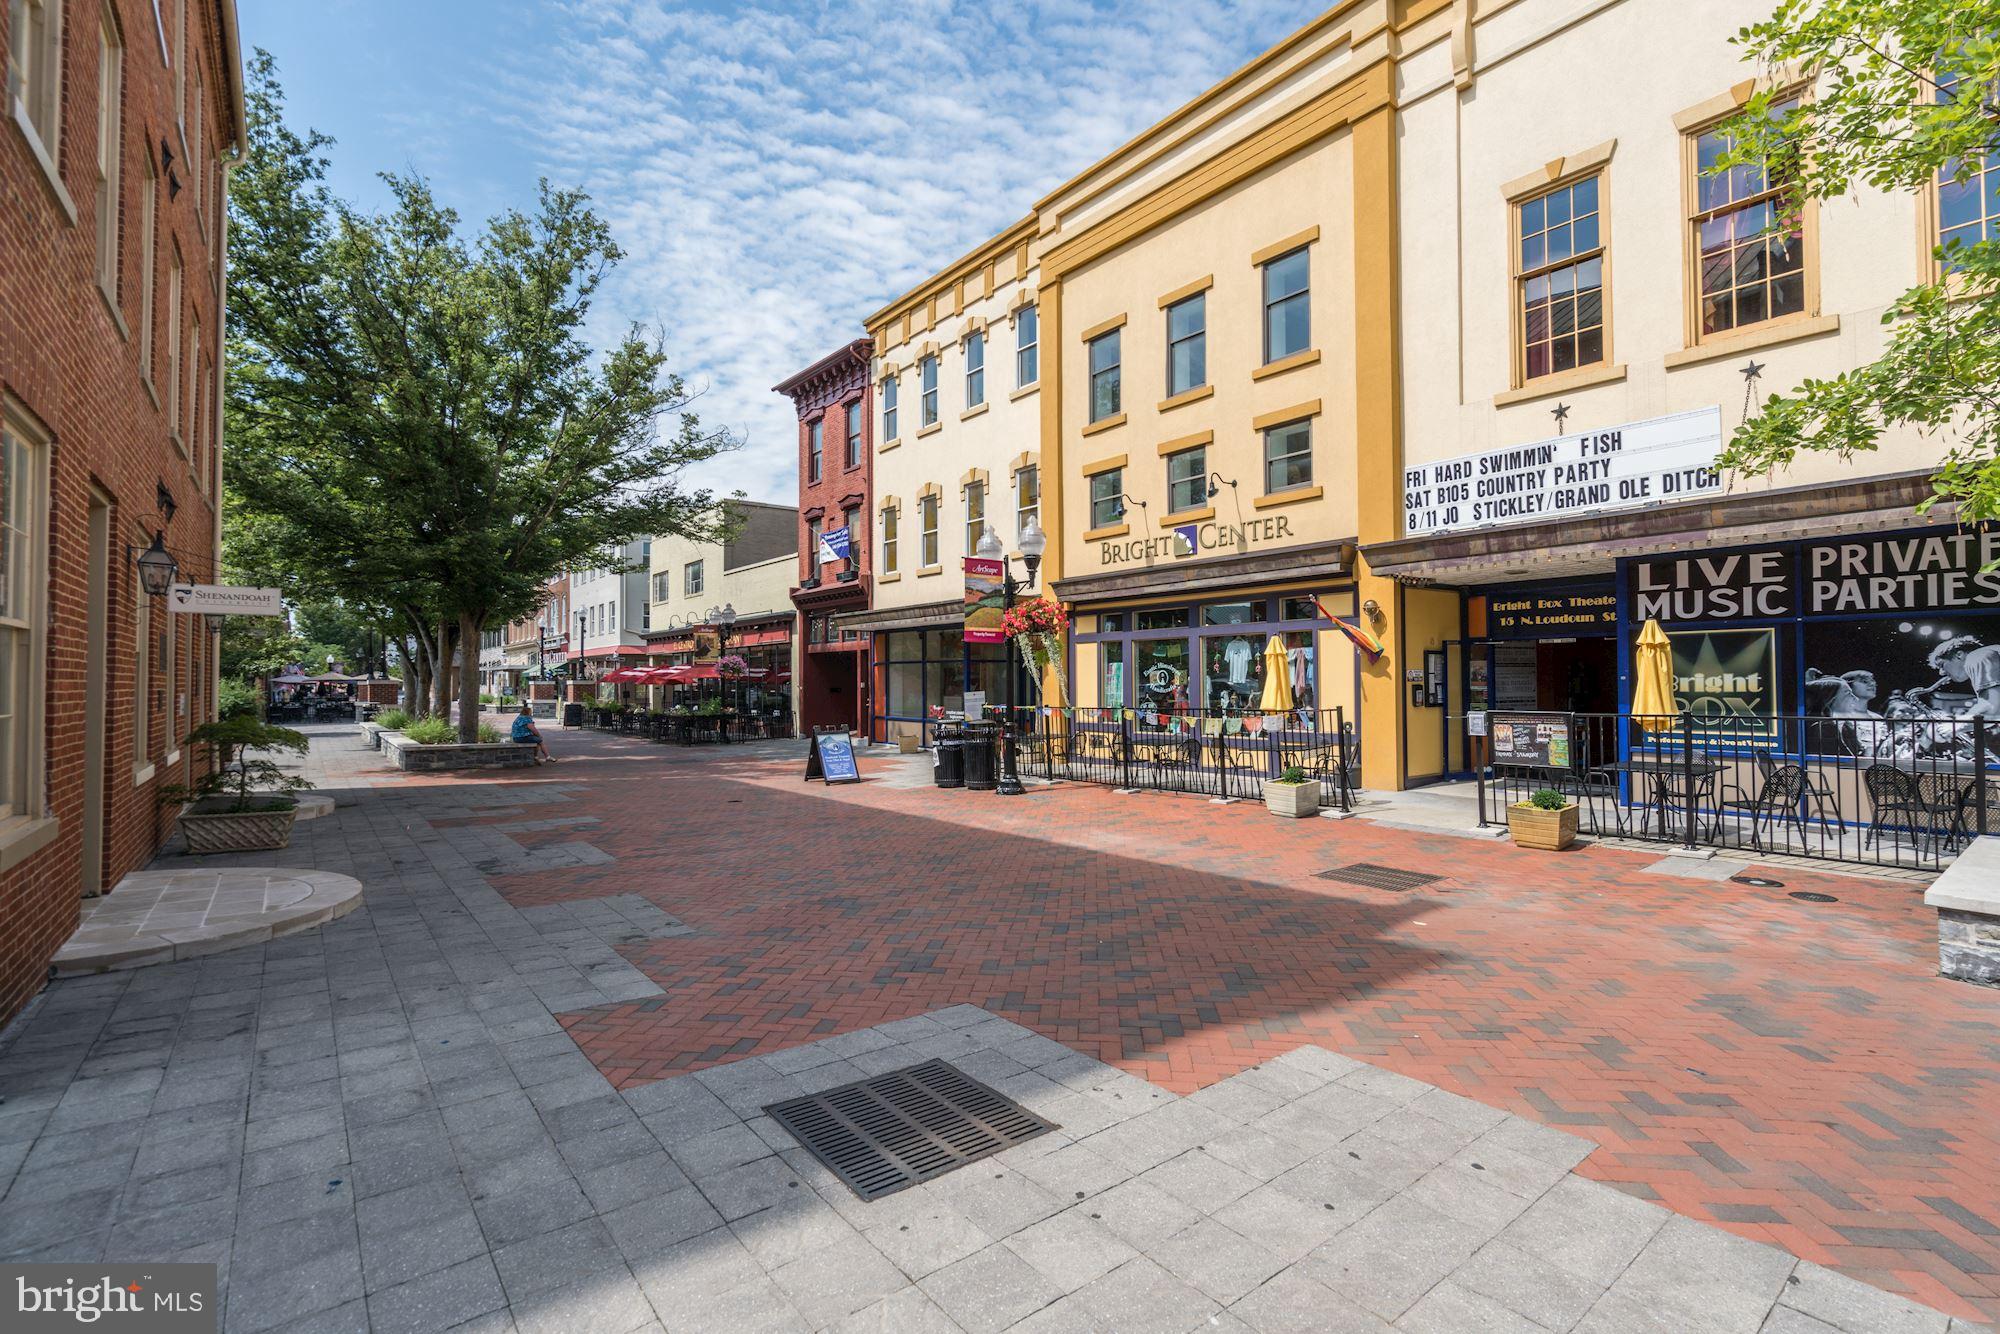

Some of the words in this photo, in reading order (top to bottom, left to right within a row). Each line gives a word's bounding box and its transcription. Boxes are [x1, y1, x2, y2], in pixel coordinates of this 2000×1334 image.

[1406, 469, 1426, 489] FRI
[1435, 460, 1472, 484] HARD
[1580, 431, 1622, 457] FISH
[1405, 489, 1431, 510] SAT
[1437, 483, 1469, 505] B105
[1477, 469, 1546, 498] COUNTRY
[1554, 458, 1611, 486] PARTY
[1442, 506, 1459, 525] JO
[1619, 476, 1650, 500] OLE
[1662, 467, 1720, 494] DITCH
[1100, 535, 1171, 565] BRIGHT
[1200, 515, 1294, 550] CENTER
[1812, 532, 2000, 579] PRIVATE
[1637, 551, 1787, 592] LIVE
[1812, 570, 2000, 612] PARTIES
[195, 590, 271, 602] SHENANDOAH
[1493, 600, 1532, 612] Bright
[1537, 599, 1563, 609] Box
[1637, 585, 1788, 621] MUSIC
[1535, 614, 1595, 625] Loudoun
